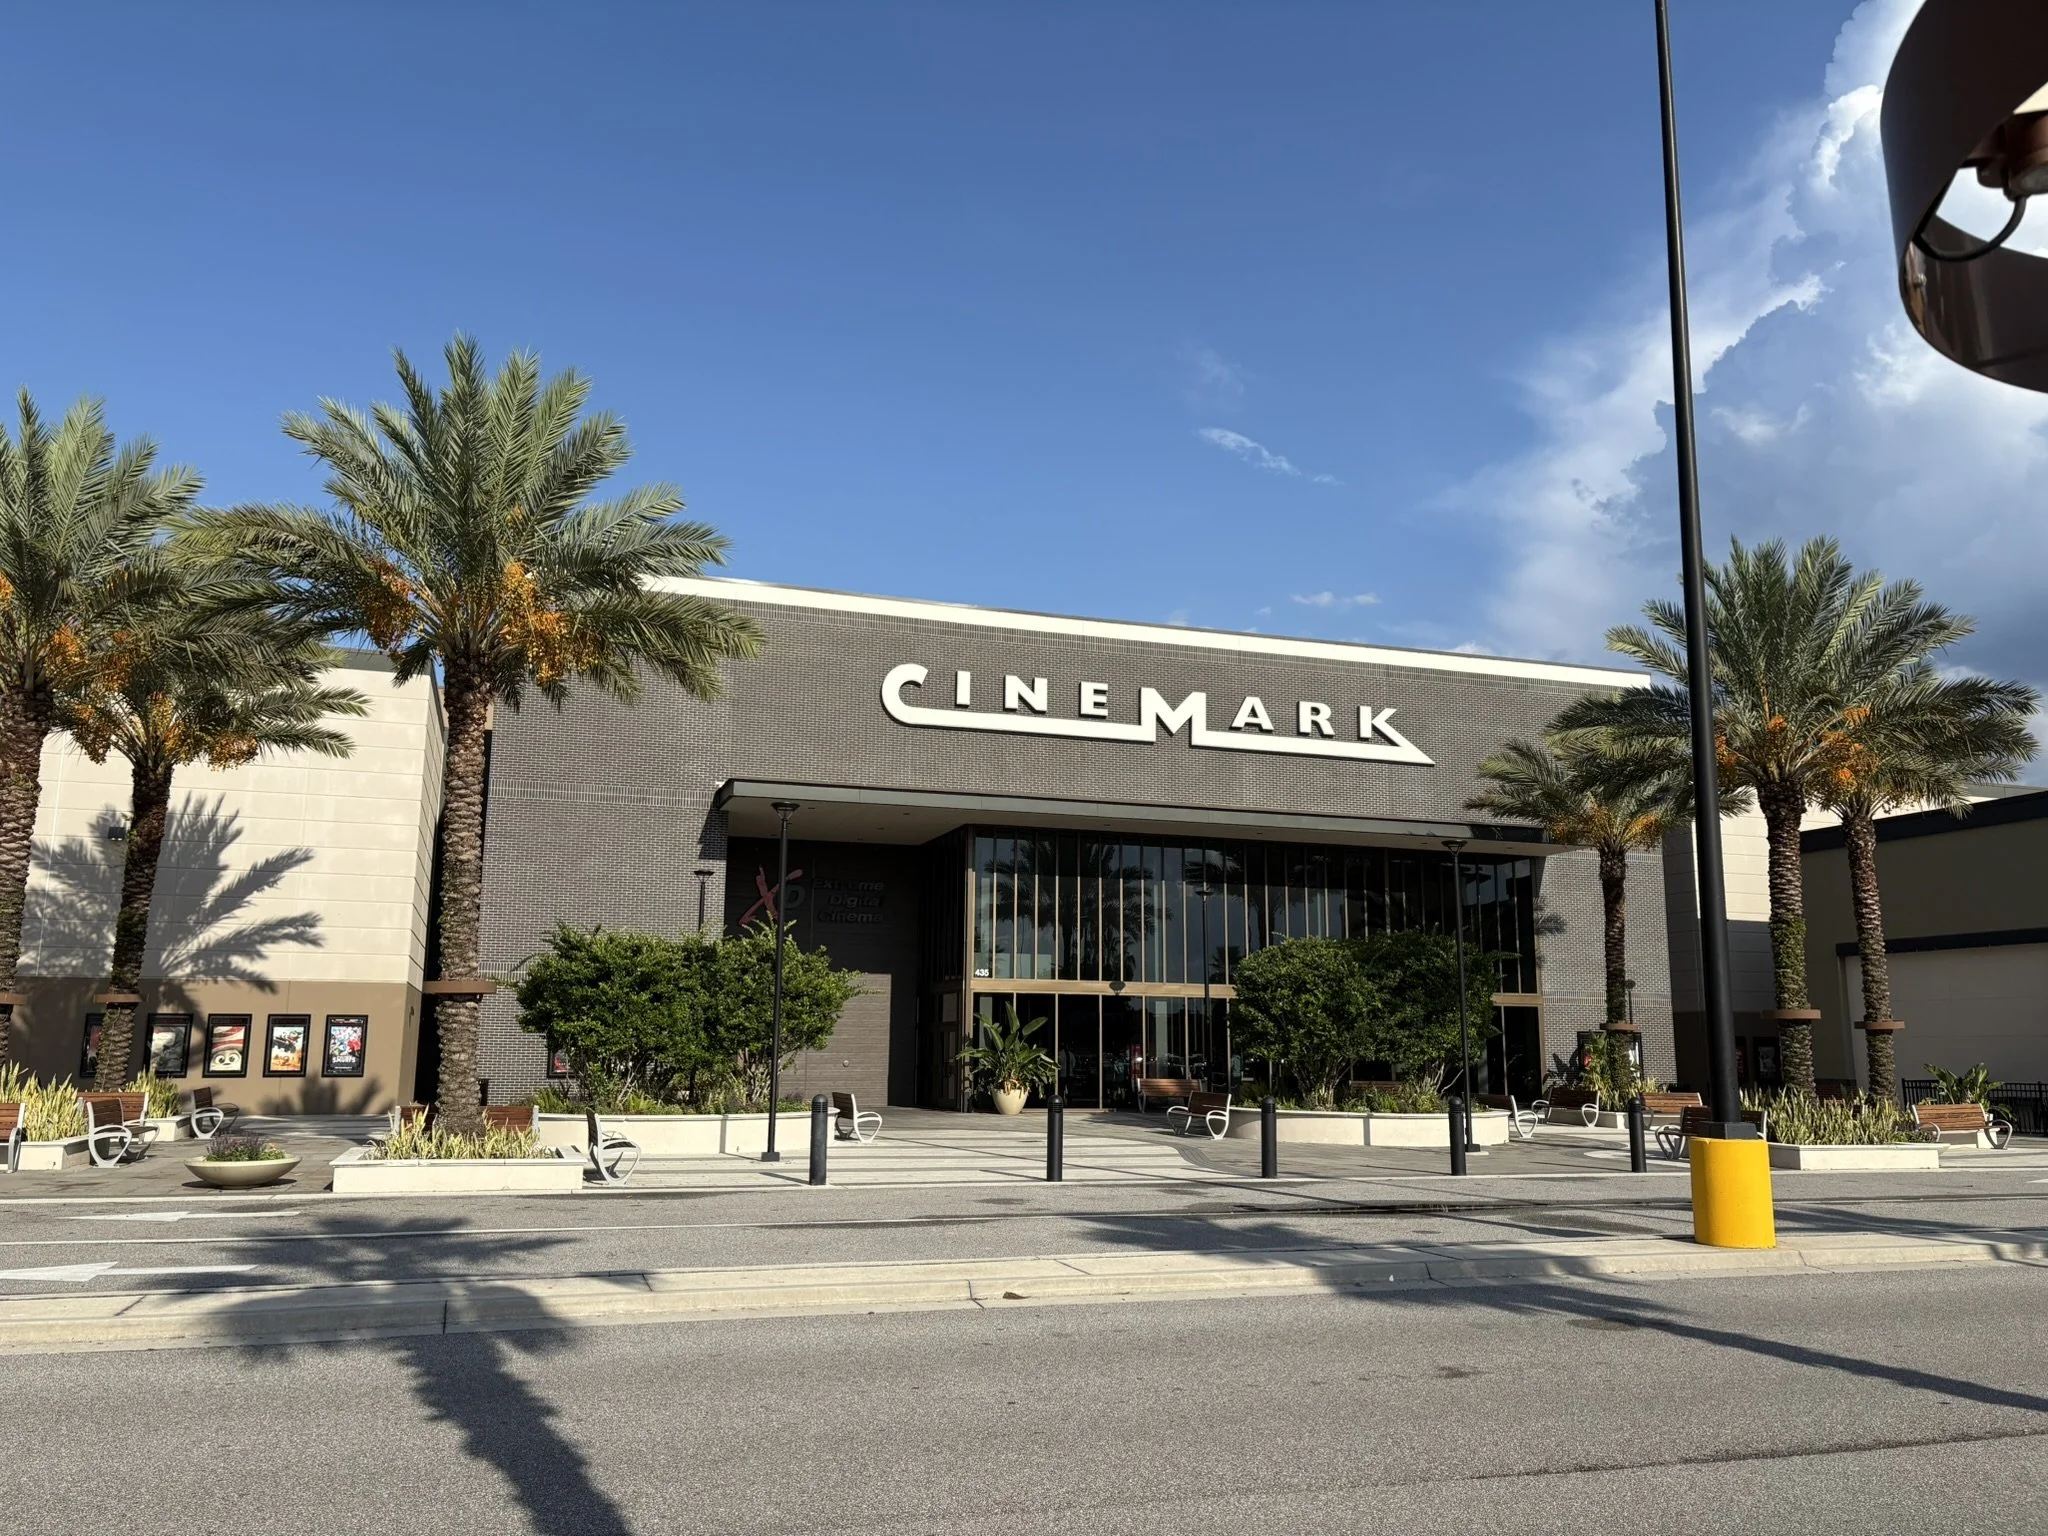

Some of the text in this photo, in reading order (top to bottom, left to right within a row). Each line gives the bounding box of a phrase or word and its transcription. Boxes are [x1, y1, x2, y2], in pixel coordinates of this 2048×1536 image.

[881, 663, 1436, 766] CINEMARK
[813, 878, 884, 891] Exteme
[975, 968, 990, 977] 435
